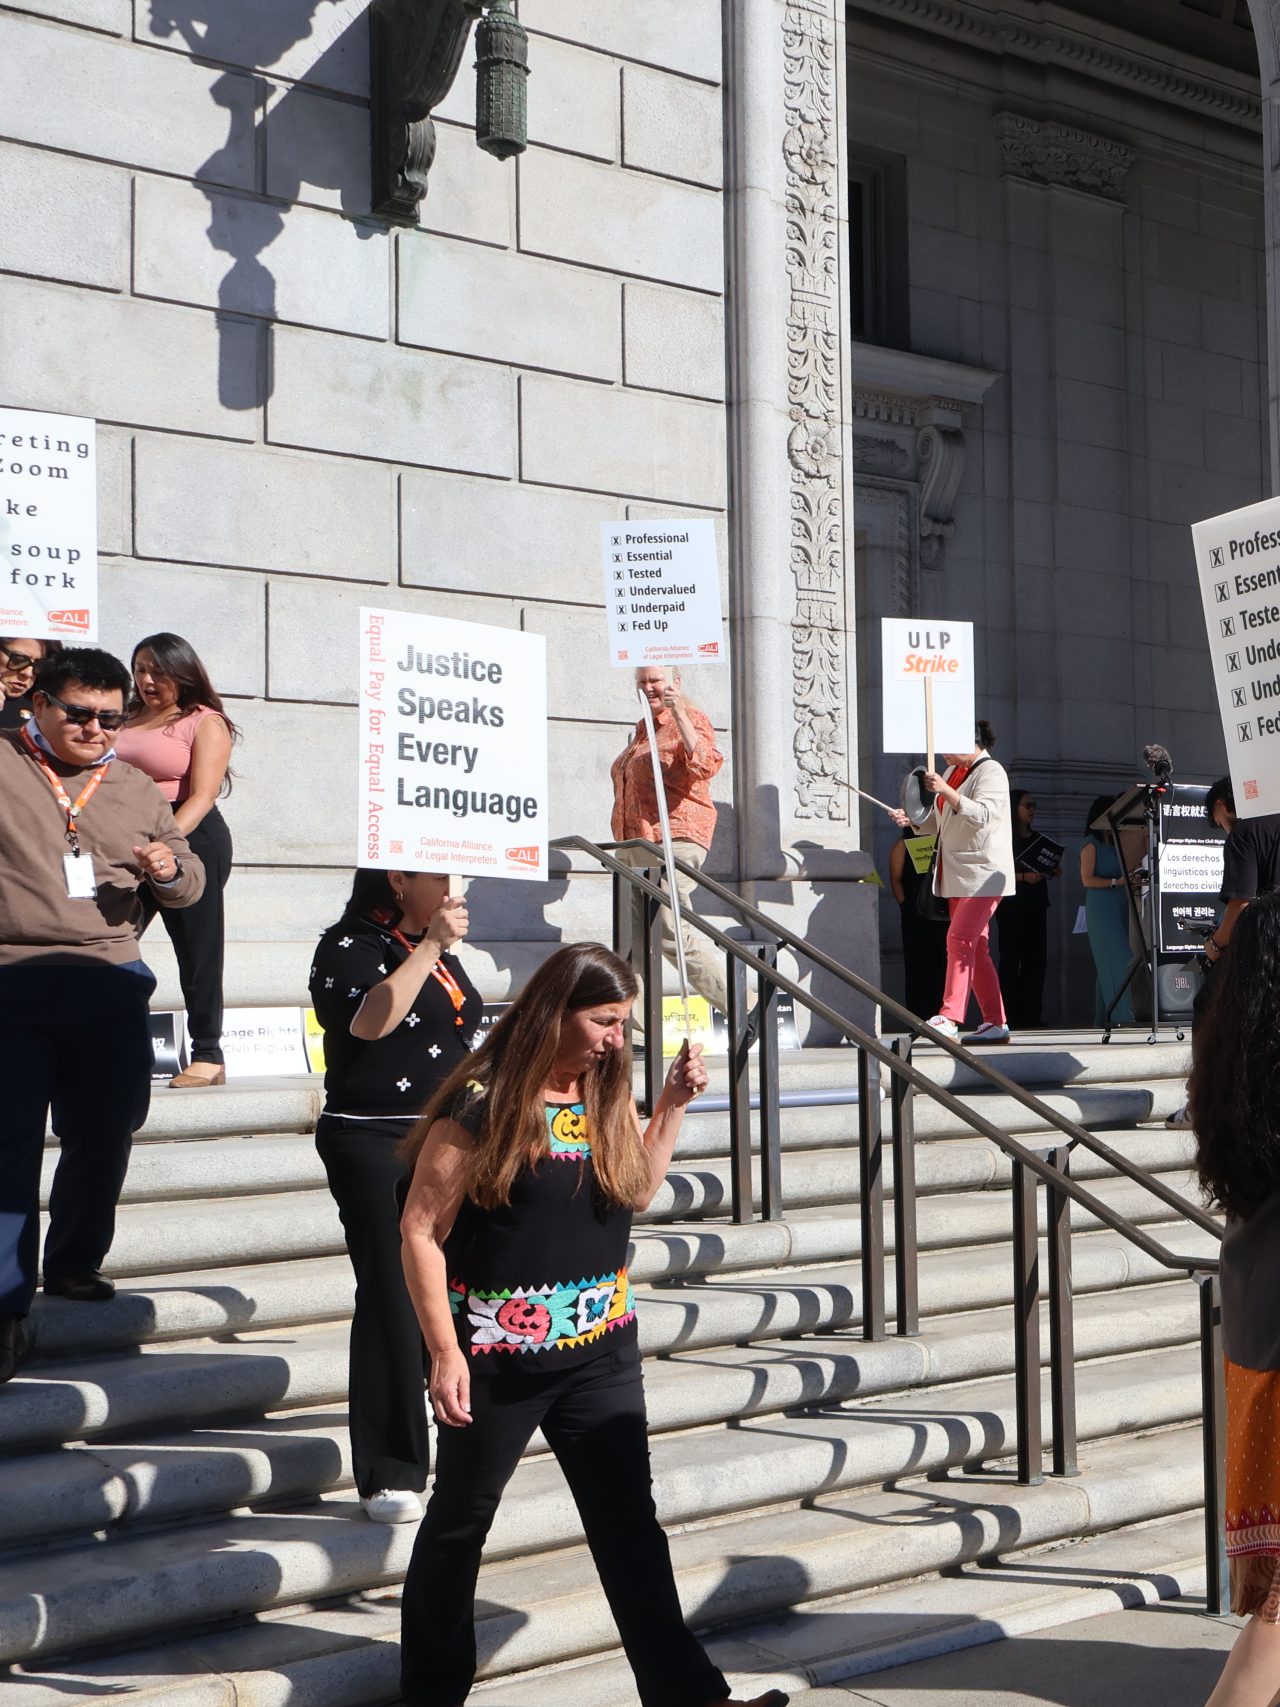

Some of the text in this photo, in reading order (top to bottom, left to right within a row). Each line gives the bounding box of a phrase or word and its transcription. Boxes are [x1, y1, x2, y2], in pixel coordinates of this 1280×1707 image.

[626, 532, 689, 544] Professional
[11, 543, 81, 565] soup
[627, 550, 672, 562] Essential
[10, 568, 76, 589] fork
[628, 568, 662, 579] Tested
[630, 584, 696, 596] Undervalued
[631, 601, 685, 615] Underpaid
[48, 611, 88, 625] CALI
[632, 620, 650, 630] Fed
[654, 620, 668, 632] Up
[908, 632, 951, 649] ULP
[397, 645, 502, 684] Justice
[903, 654, 959, 673] Strike
[397, 688, 504, 727] Speaks
[365, 614, 386, 860] Equal Pay for Equal Access
[398, 732, 478, 774] Every
[397, 777, 538, 823] Language
[420, 837, 493, 851] California Alliance
[415, 850, 498, 865] of Legal Interpreters
[505, 848, 538, 862] CALI
[1182, 854, 1220, 862] derechos
[1175, 978, 1190, 989] JBL
